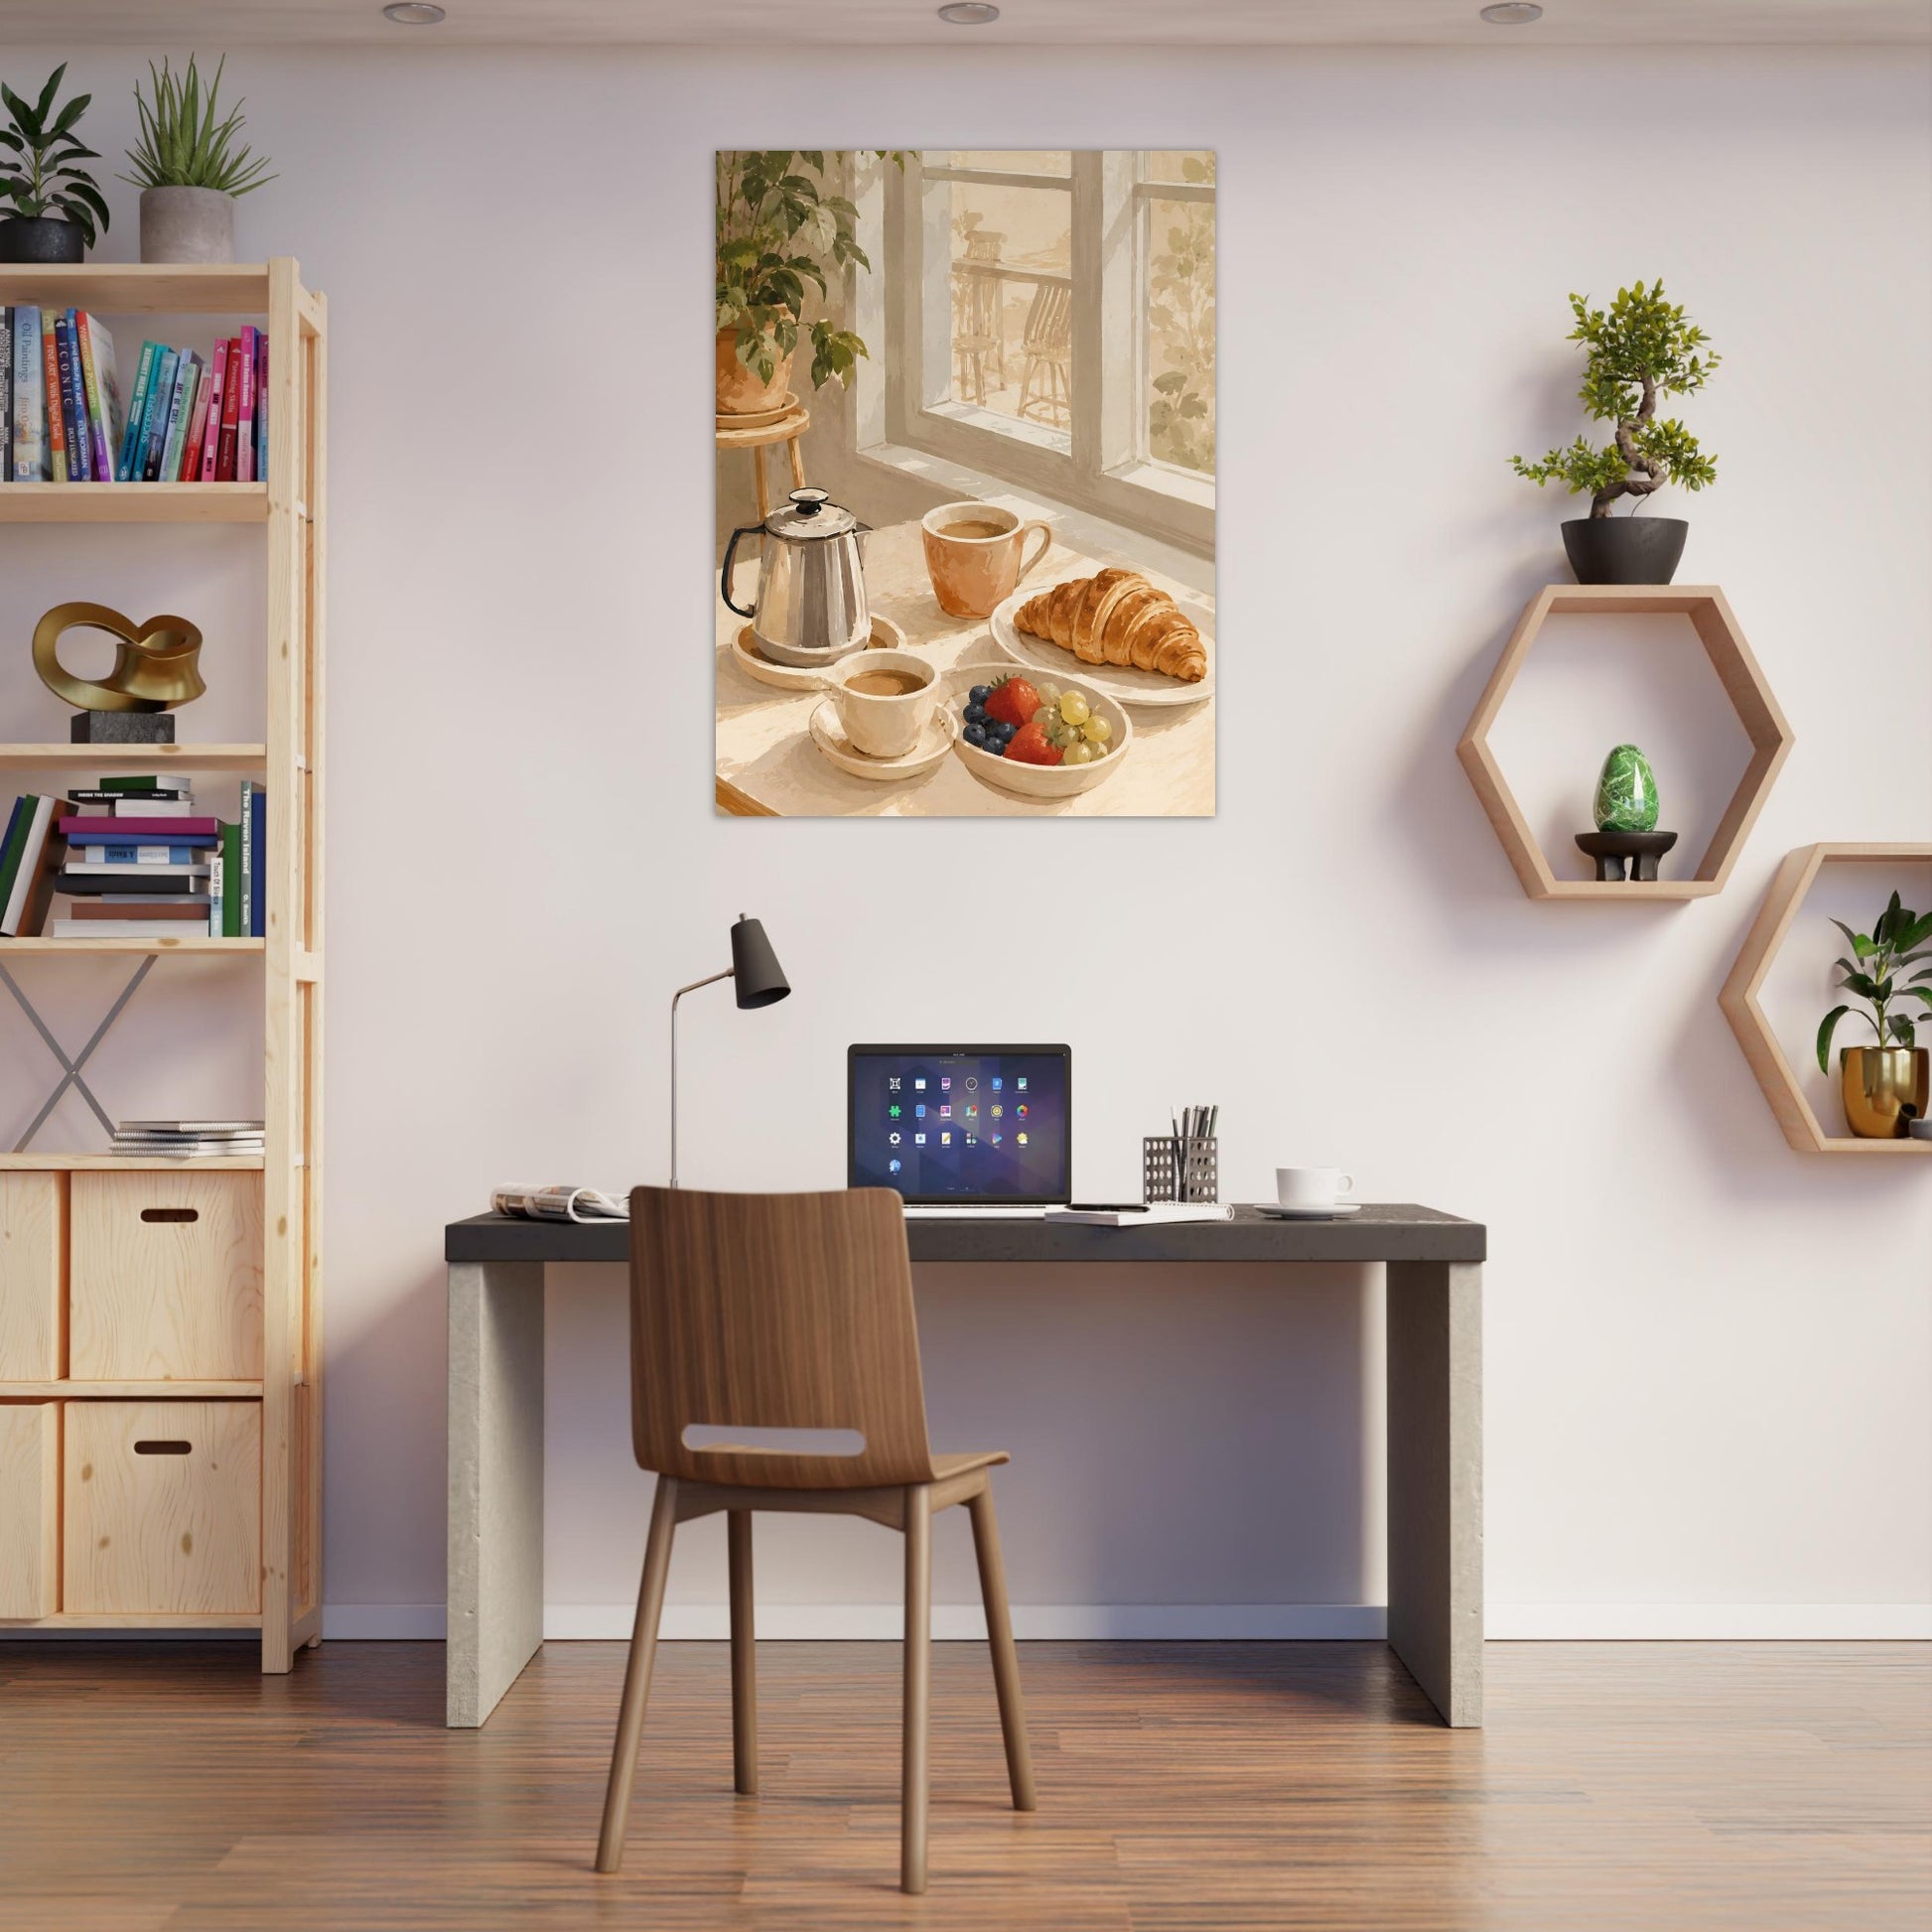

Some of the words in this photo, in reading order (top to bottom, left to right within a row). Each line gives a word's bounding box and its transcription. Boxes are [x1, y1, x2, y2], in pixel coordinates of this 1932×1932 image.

[22, 323, 33, 337] Oil
[19, 340, 31, 383] Paintings
[48, 361, 57, 377] ART
[59, 342, 72, 405] ICONIC
[71, 356, 80, 382] Beauty
[79, 325, 91, 371] Watercolor
[86, 372, 97, 409] Portraits
[228, 360, 238, 393] Parenting
[50, 399, 60, 421] Digital
[227, 395, 236, 412] Skills
[141, 394, 157, 443] SUCCESSFUL
